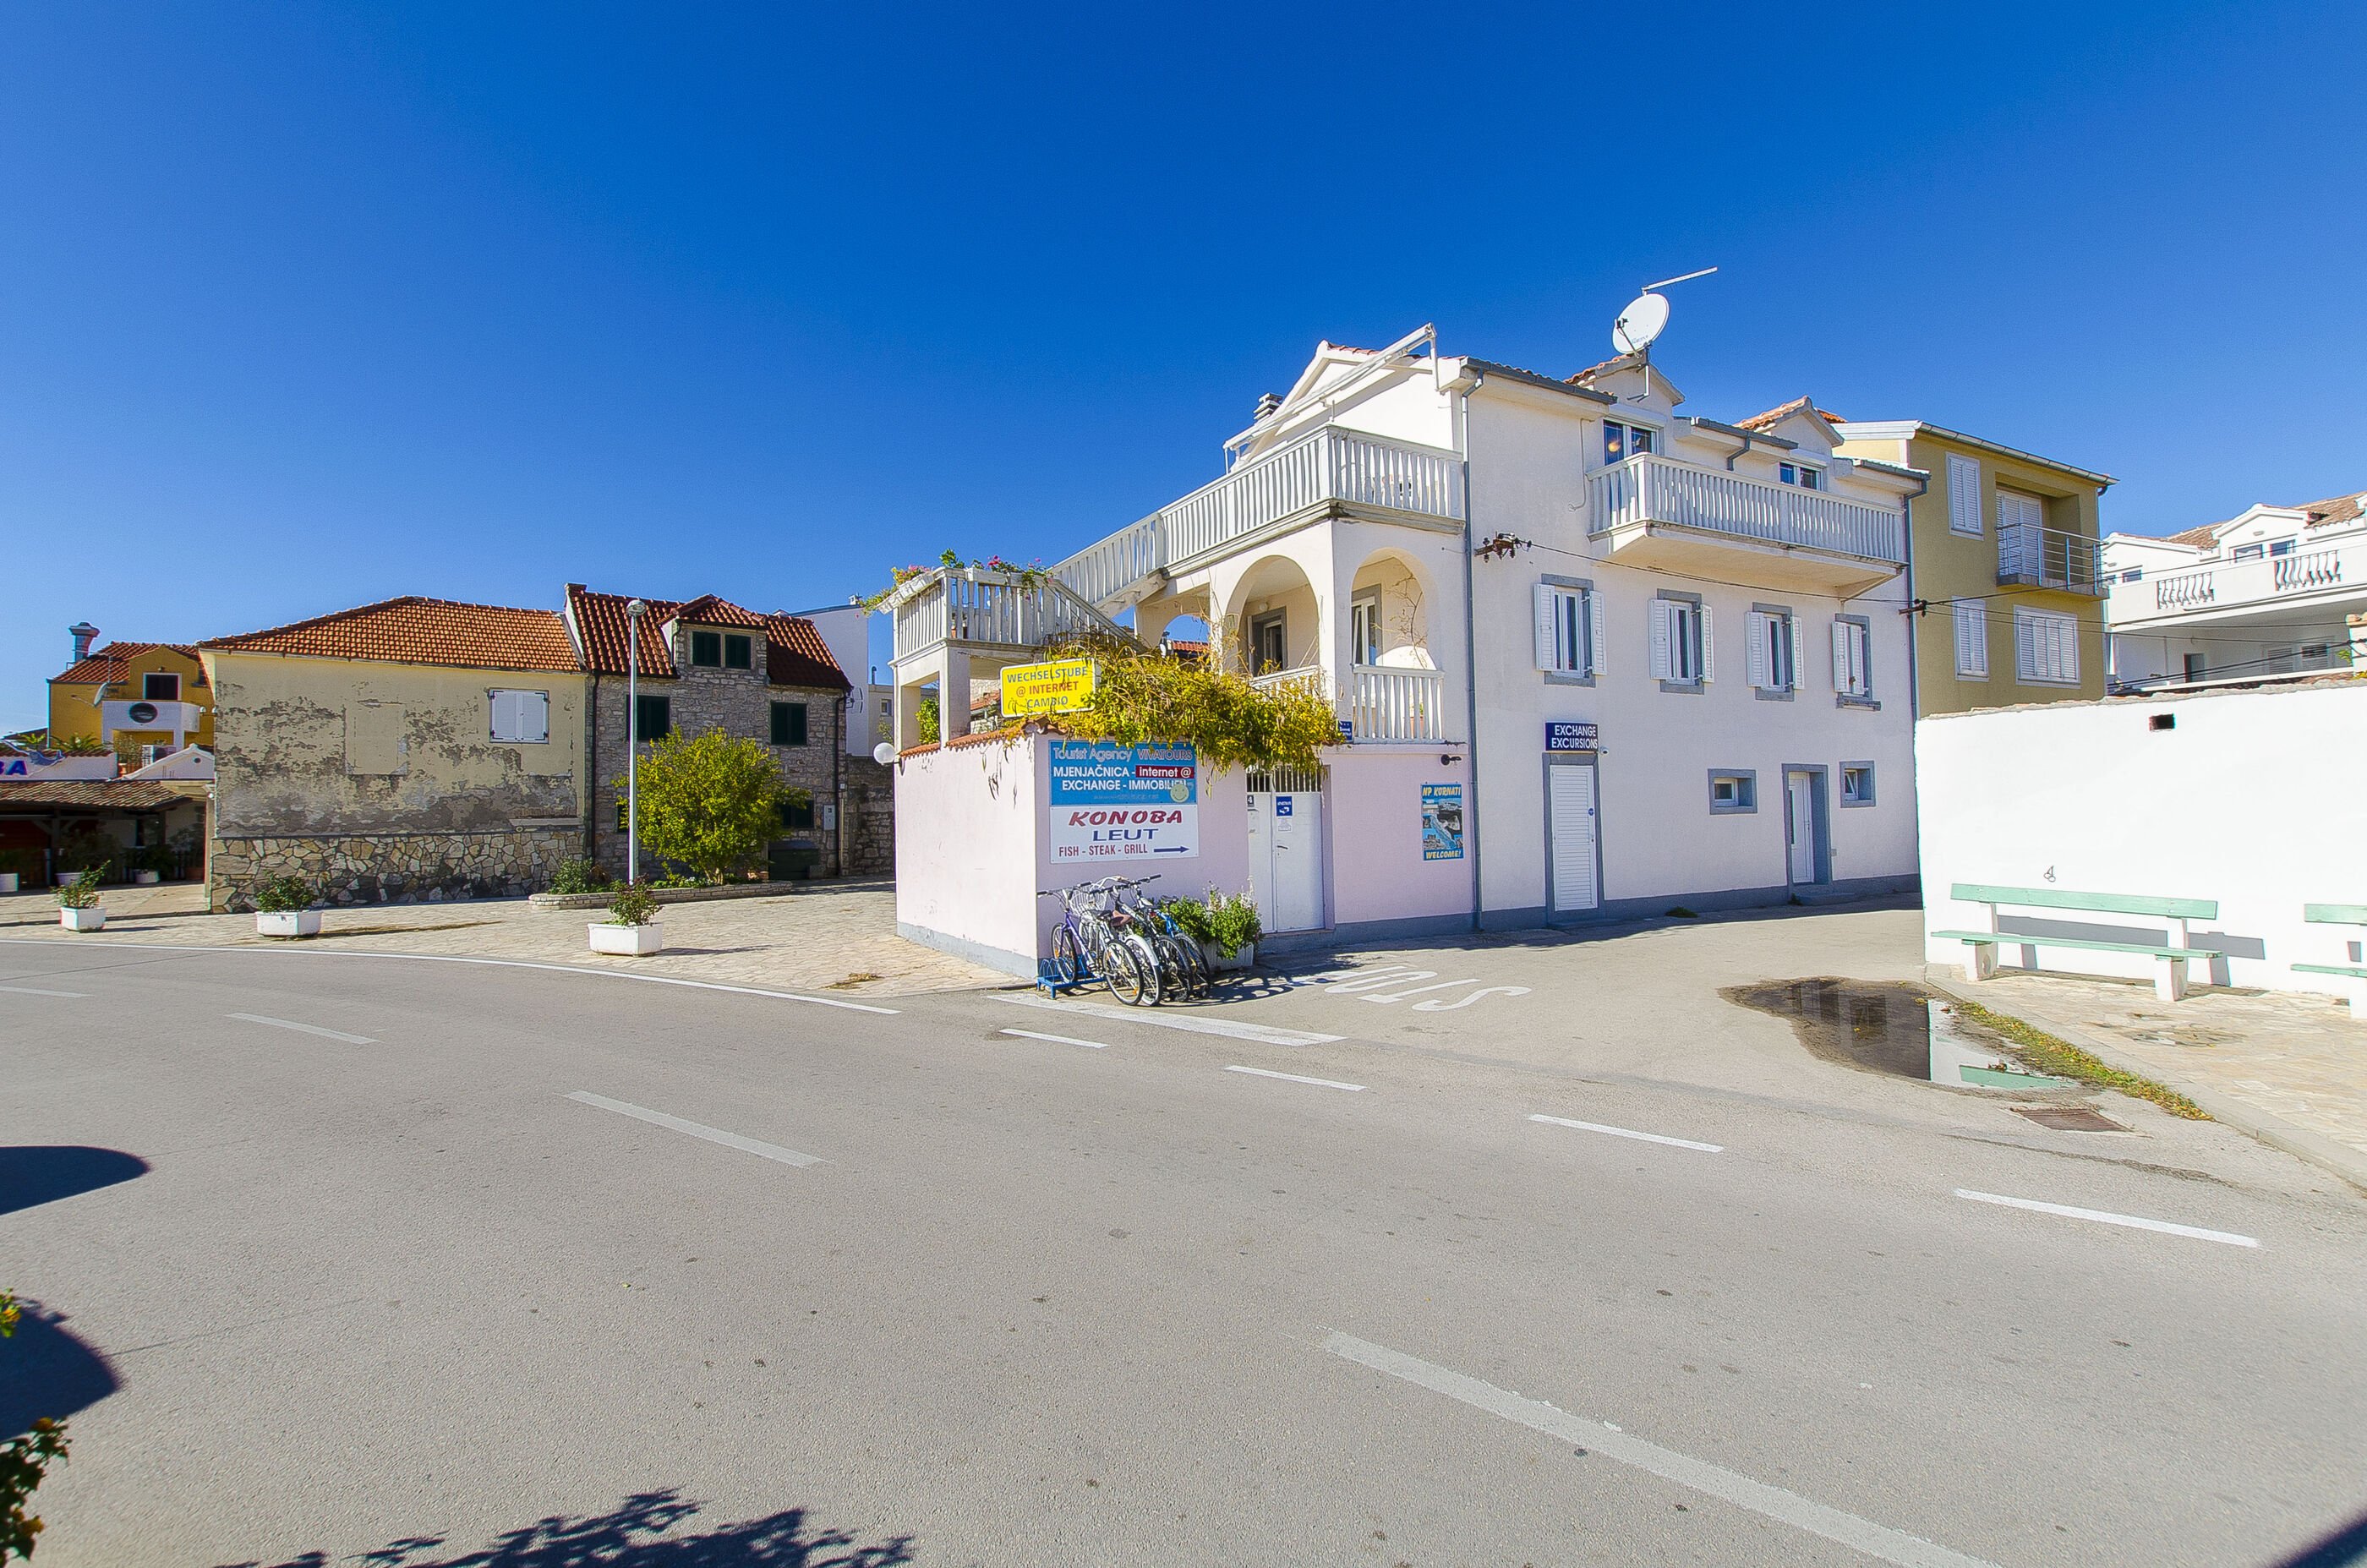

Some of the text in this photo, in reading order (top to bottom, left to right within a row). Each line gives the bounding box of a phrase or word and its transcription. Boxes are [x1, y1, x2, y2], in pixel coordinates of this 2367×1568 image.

[1007, 667, 1088, 683] WECHSELSTUBE
[1016, 680, 1079, 697] @ INTERNET
[1026, 696, 1069, 708] CAMBIO
[1555, 724, 1597, 737] EXCHANGE
[1551, 737, 1598, 749] EXCURSIONS
[1053, 748, 1087, 760] Tourist
[1089, 747, 1132, 762] Agency
[1053, 764, 1129, 778] MJENJAČNICA
[1139, 766, 1178, 778] internet
[1180, 767, 1192, 779] @
[1062, 780, 1121, 790] EXCHANGE
[1422, 786, 1462, 796] NP KORNATI
[1069, 810, 1182, 827] KONOBA
[1092, 828, 1159, 842] LEUT
[1058, 845, 1080, 857] FISH
[1089, 844, 1116, 855] STEAK
[1123, 843, 1148, 855] GRILL
[1425, 850, 1462, 860] WELCOME!
